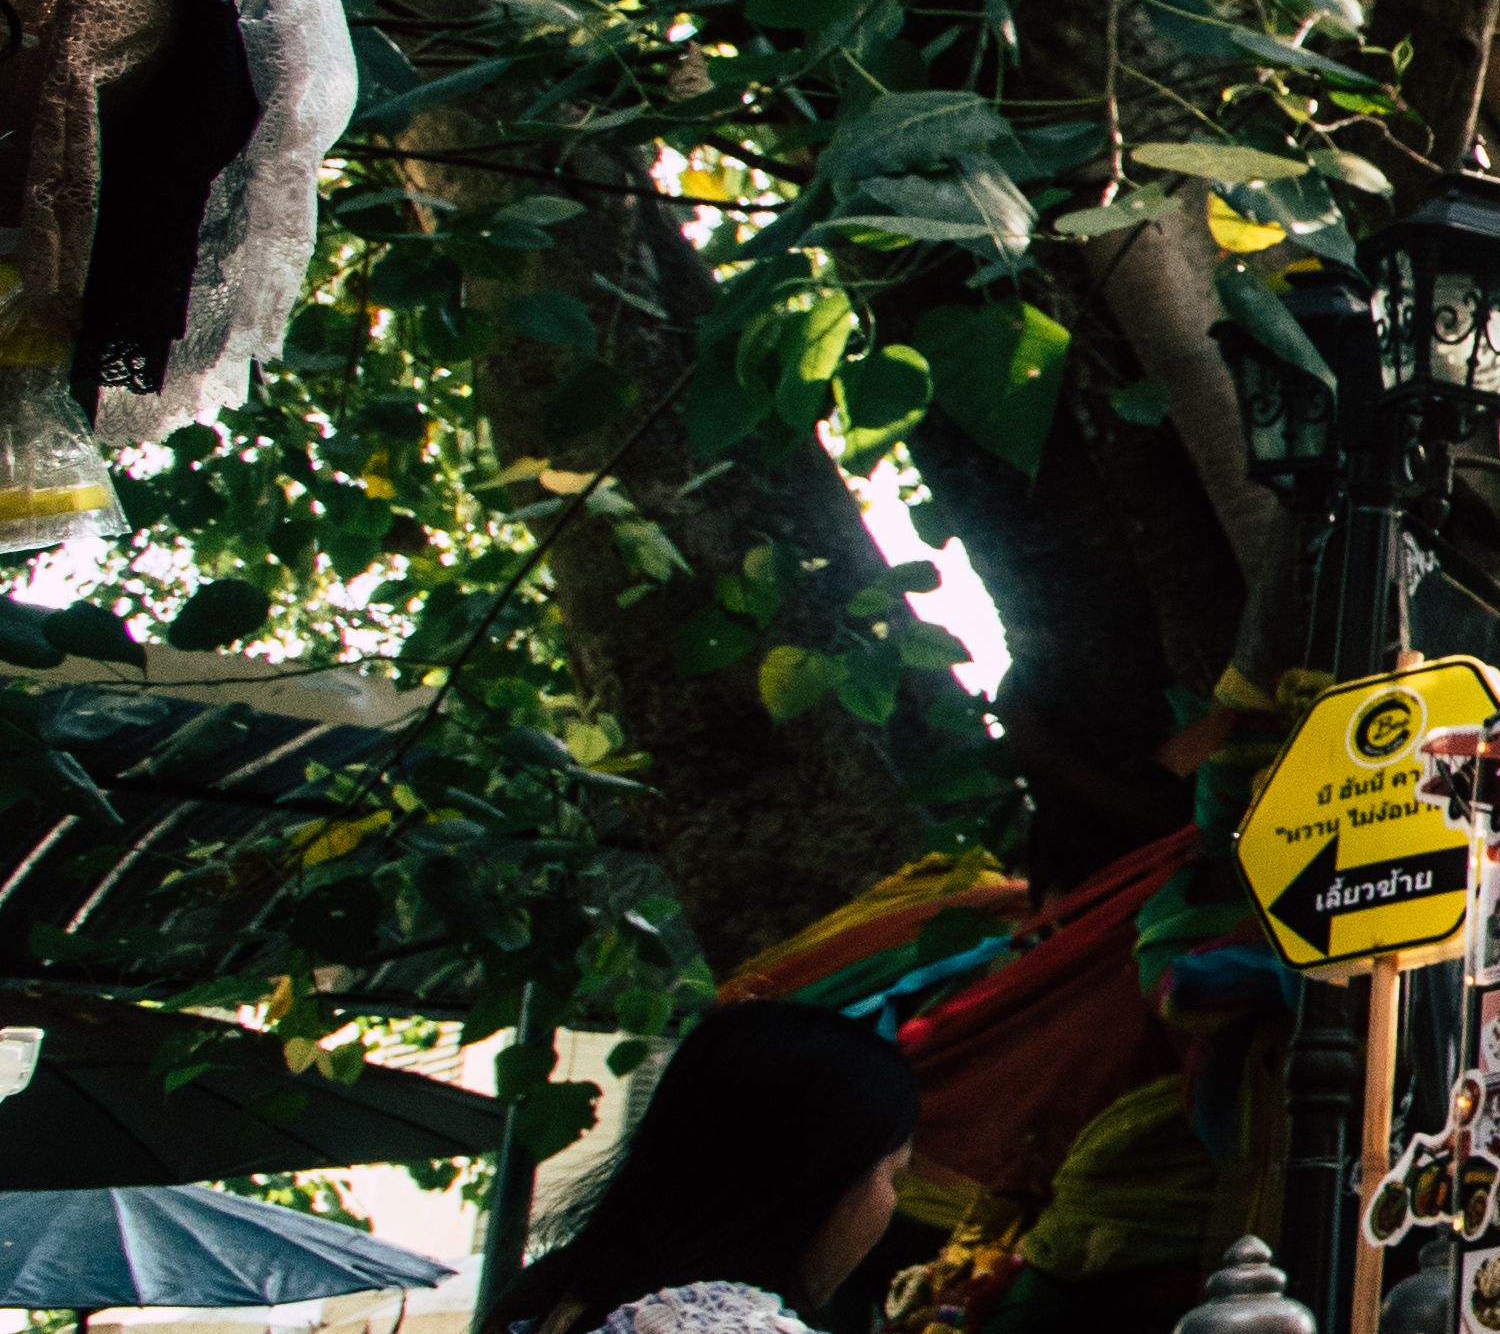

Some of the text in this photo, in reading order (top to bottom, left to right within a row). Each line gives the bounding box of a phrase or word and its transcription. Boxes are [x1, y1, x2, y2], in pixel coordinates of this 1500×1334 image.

[1392, 768, 1422, 788] คา
[1314, 868, 1434, 914] เลี้ยวซ้าย
